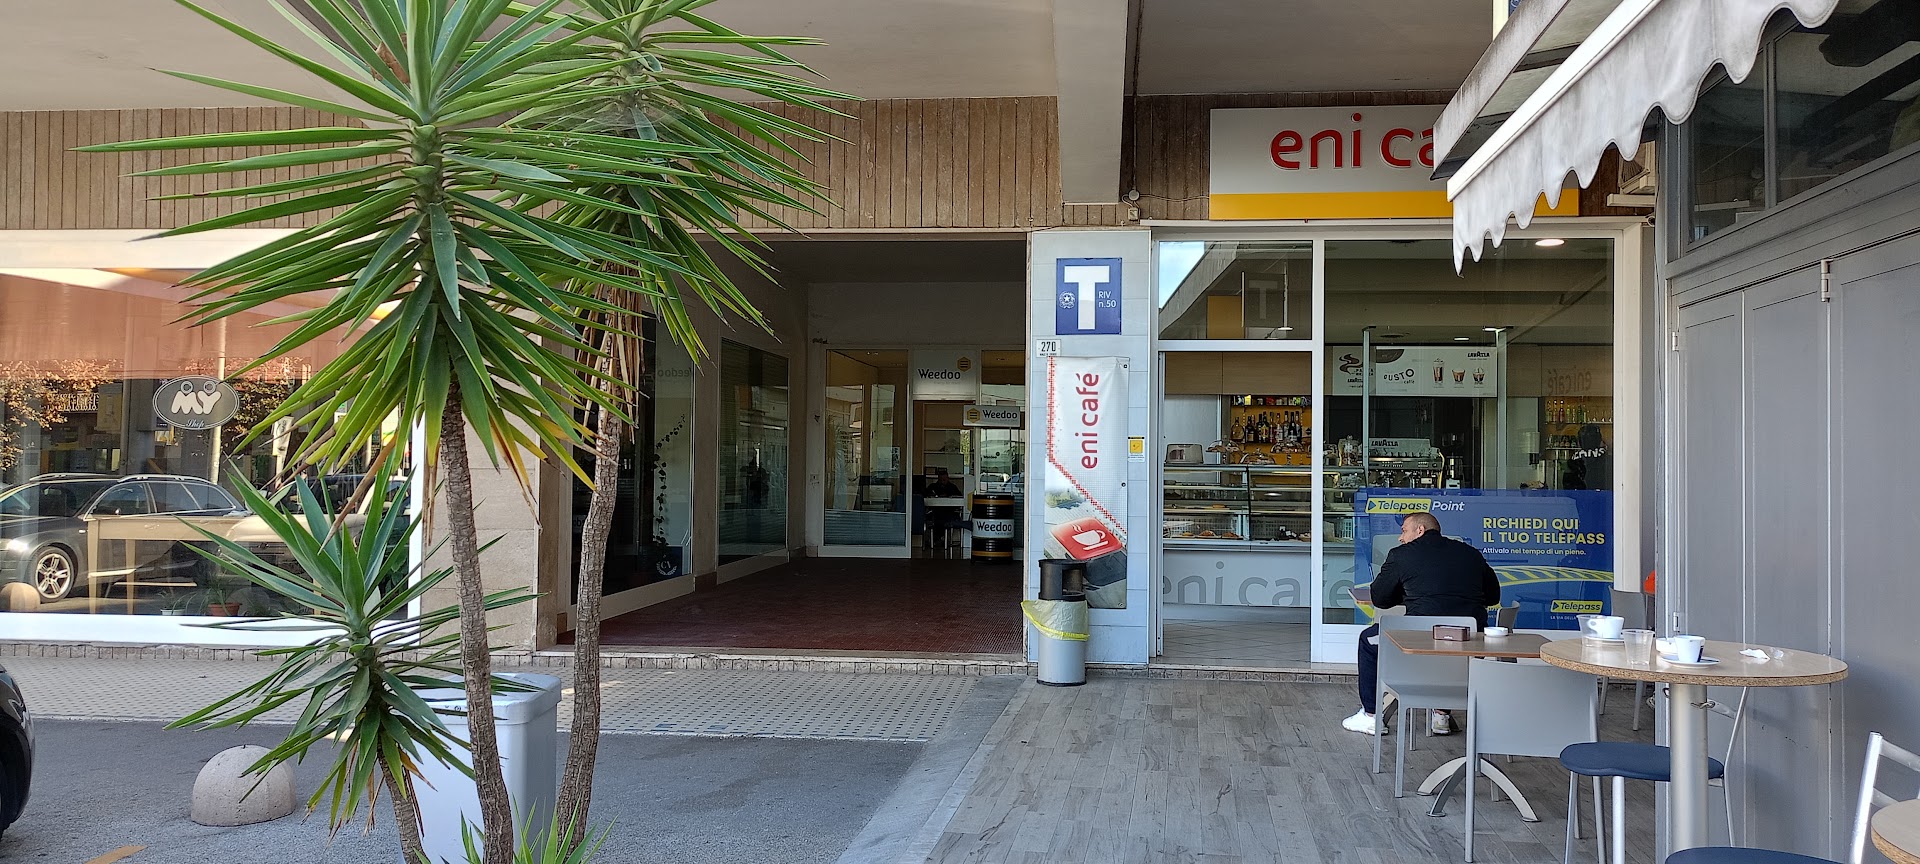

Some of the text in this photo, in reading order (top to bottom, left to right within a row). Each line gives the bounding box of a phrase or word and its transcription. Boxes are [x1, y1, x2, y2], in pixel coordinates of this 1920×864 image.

[1270, 112, 1434, 170] eni ca
[1064, 265, 1110, 330] T
[1098, 290, 1112, 299] RIV
[1098, 299, 1117, 308] n.50
[1041, 341, 1057, 352] 270
[917, 368, 961, 380] Weedoo
[170, 390, 222, 415] MY
[982, 409, 1018, 419] Weedoo
[1074, 372, 1099, 469] eni café
[1371, 439, 1399, 447] LAVAZZA
[1378, 500, 1465, 512] Telepass Point
[976, 521, 1013, 532] Weedoo
[1483, 517, 1579, 531] RICHIEDI QUI
[1483, 531, 1605, 544] IL TUO TELEPASS
[1522, 548, 1546, 556] tempo
[1564, 548, 1587, 556] pieno.
[1163, 560, 1359, 607] ni caé
[1560, 602, 1601, 611] Telepass
